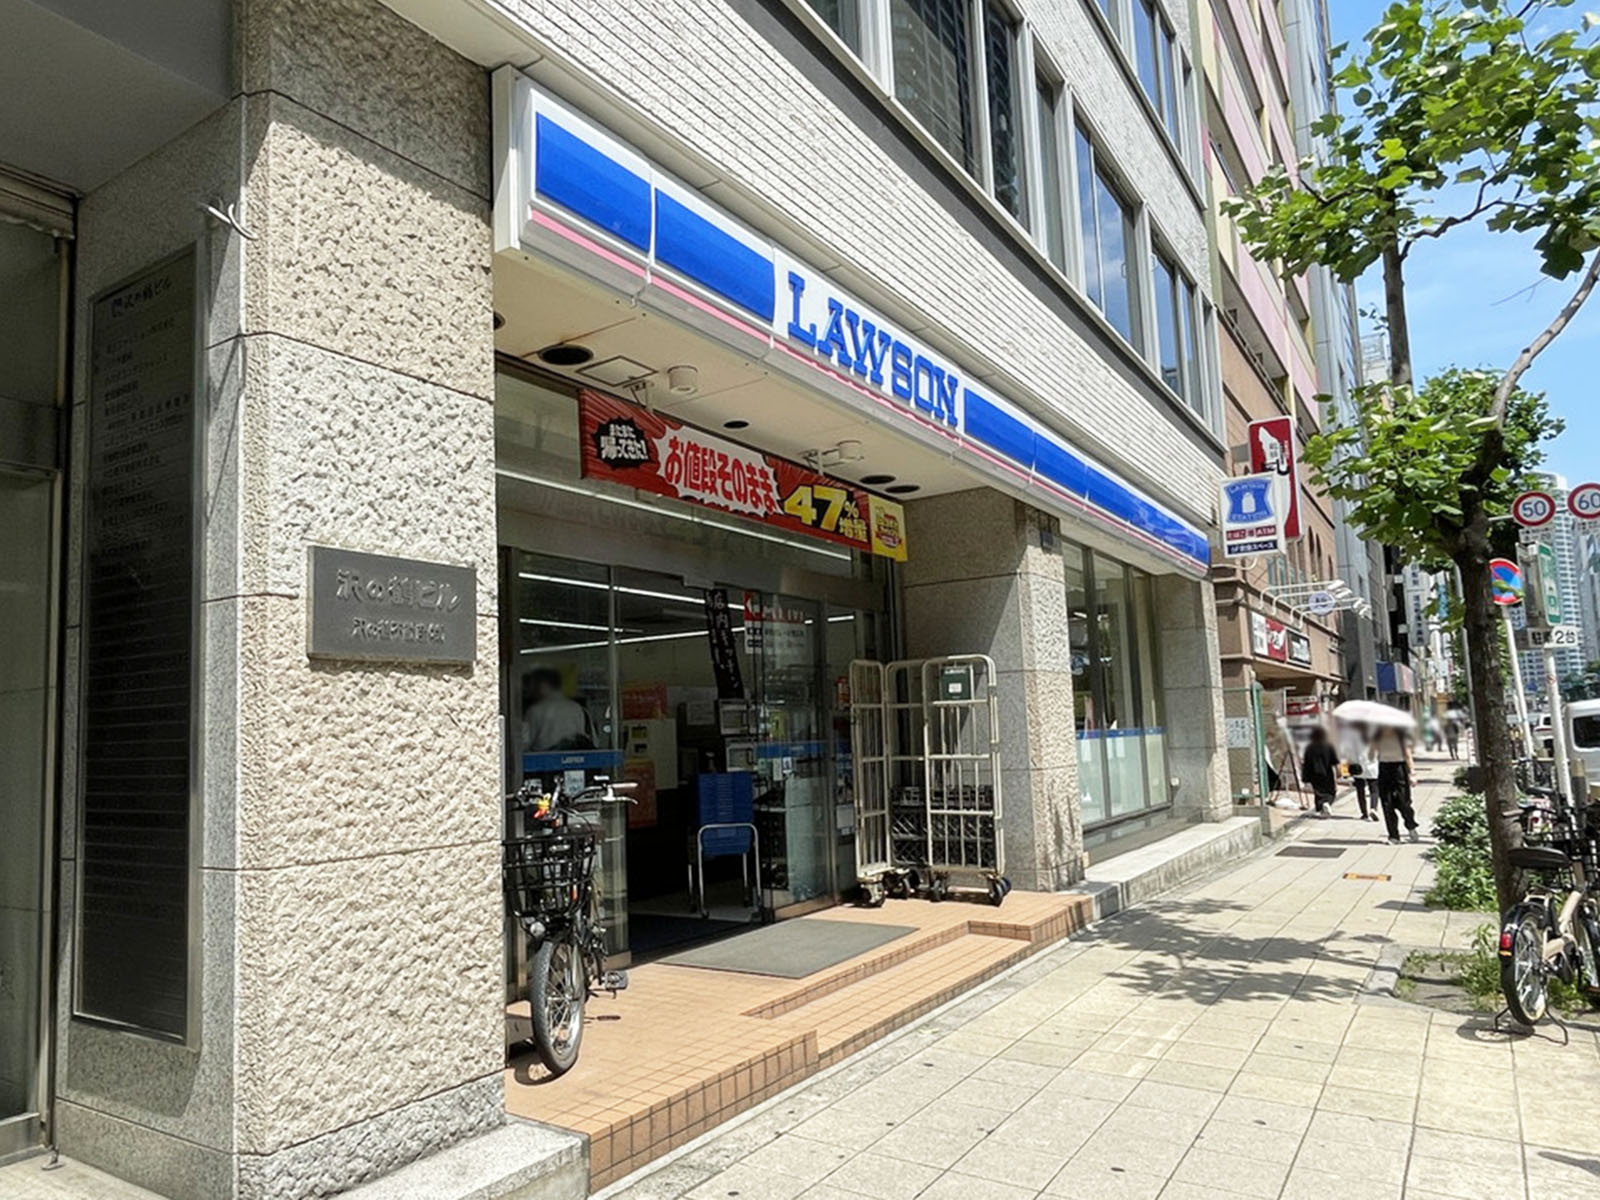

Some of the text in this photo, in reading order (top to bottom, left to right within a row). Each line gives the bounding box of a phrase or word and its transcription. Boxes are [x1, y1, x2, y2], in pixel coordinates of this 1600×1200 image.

[788, 271, 958, 427] LAWSON
[664, 436, 777, 515] お値段そのまま
[1522, 500, 1547, 518] 50
[1578, 492, 1600, 511] 60
[839, 517, 868, 543] 増量
